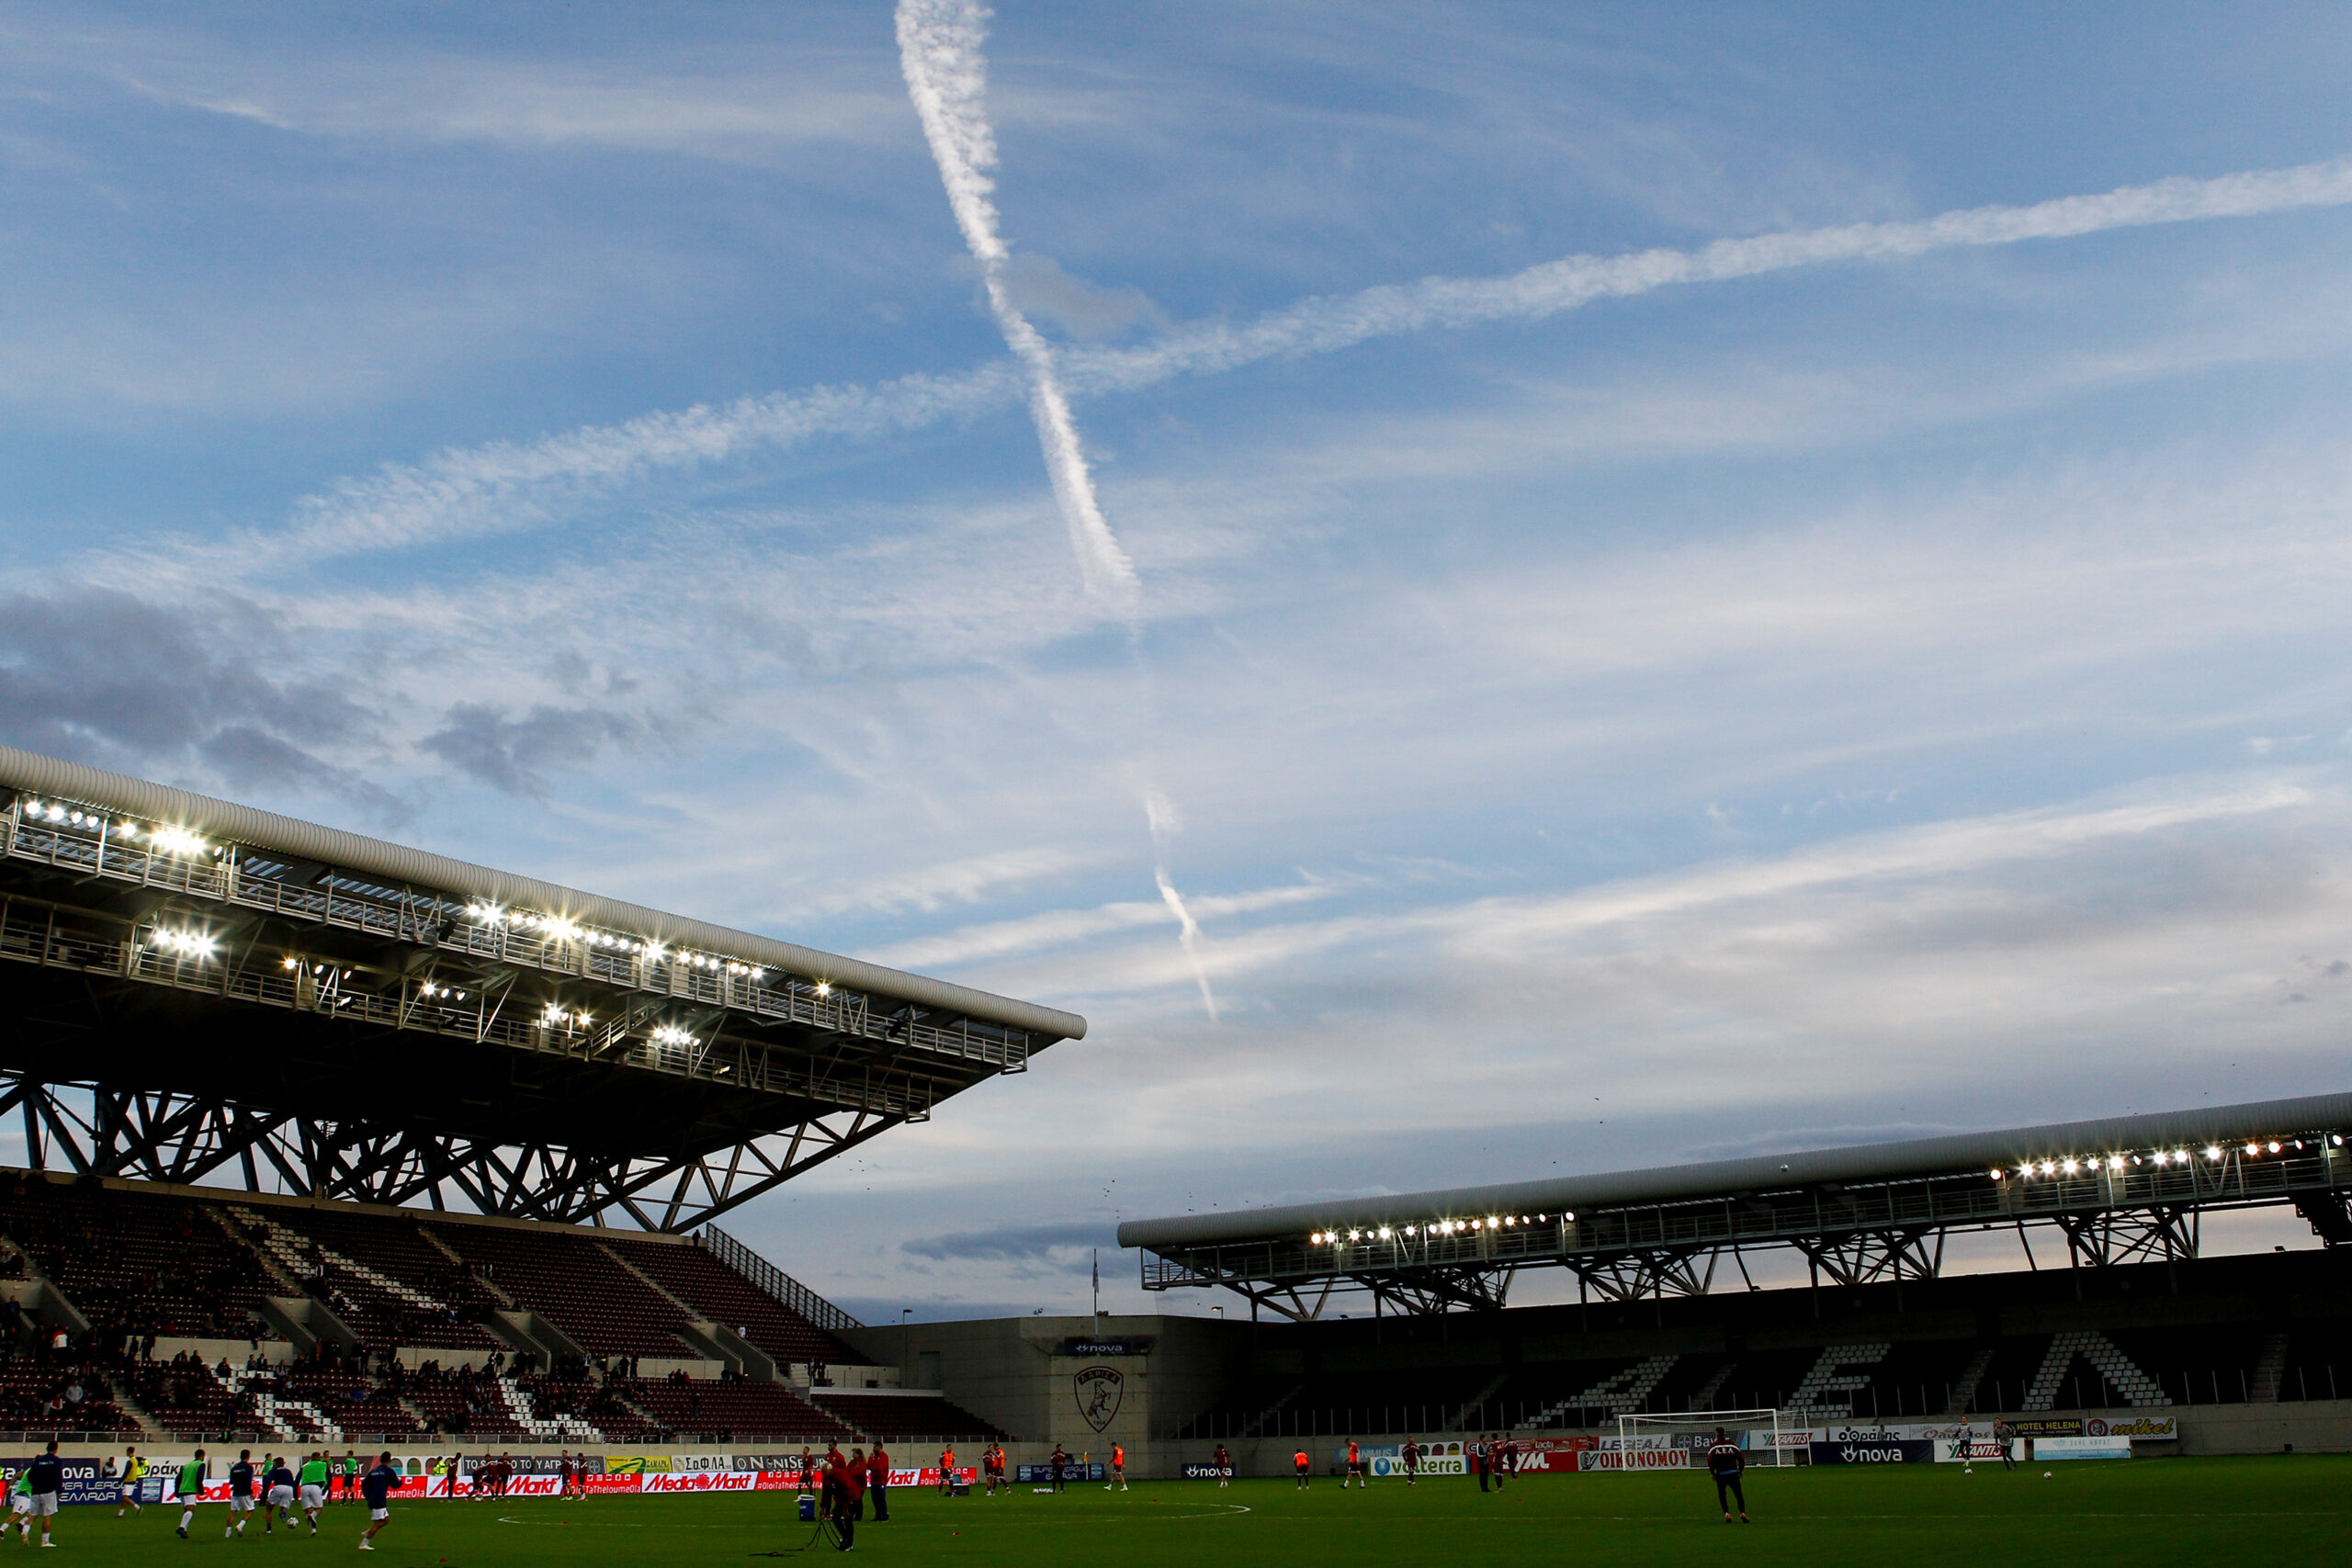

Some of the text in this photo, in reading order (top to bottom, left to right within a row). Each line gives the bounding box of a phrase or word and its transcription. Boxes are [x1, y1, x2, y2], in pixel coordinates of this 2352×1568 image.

[1089, 1344, 1123, 1352] nova
[2016, 1421, 2081, 1432] HOTEL HELENA
[2110, 1417, 2175, 1437] mikel
[1693, 1434, 1730, 1450] Bayr
[1859, 1447, 1904, 1462] nova
[62, 1466, 96, 1480] ova
[1200, 1467, 1233, 1477] nova
[86, 1482, 139, 1490] LEAG
[504, 1475, 560, 1494] Markt
[644, 1472, 752, 1492] Media Markt
